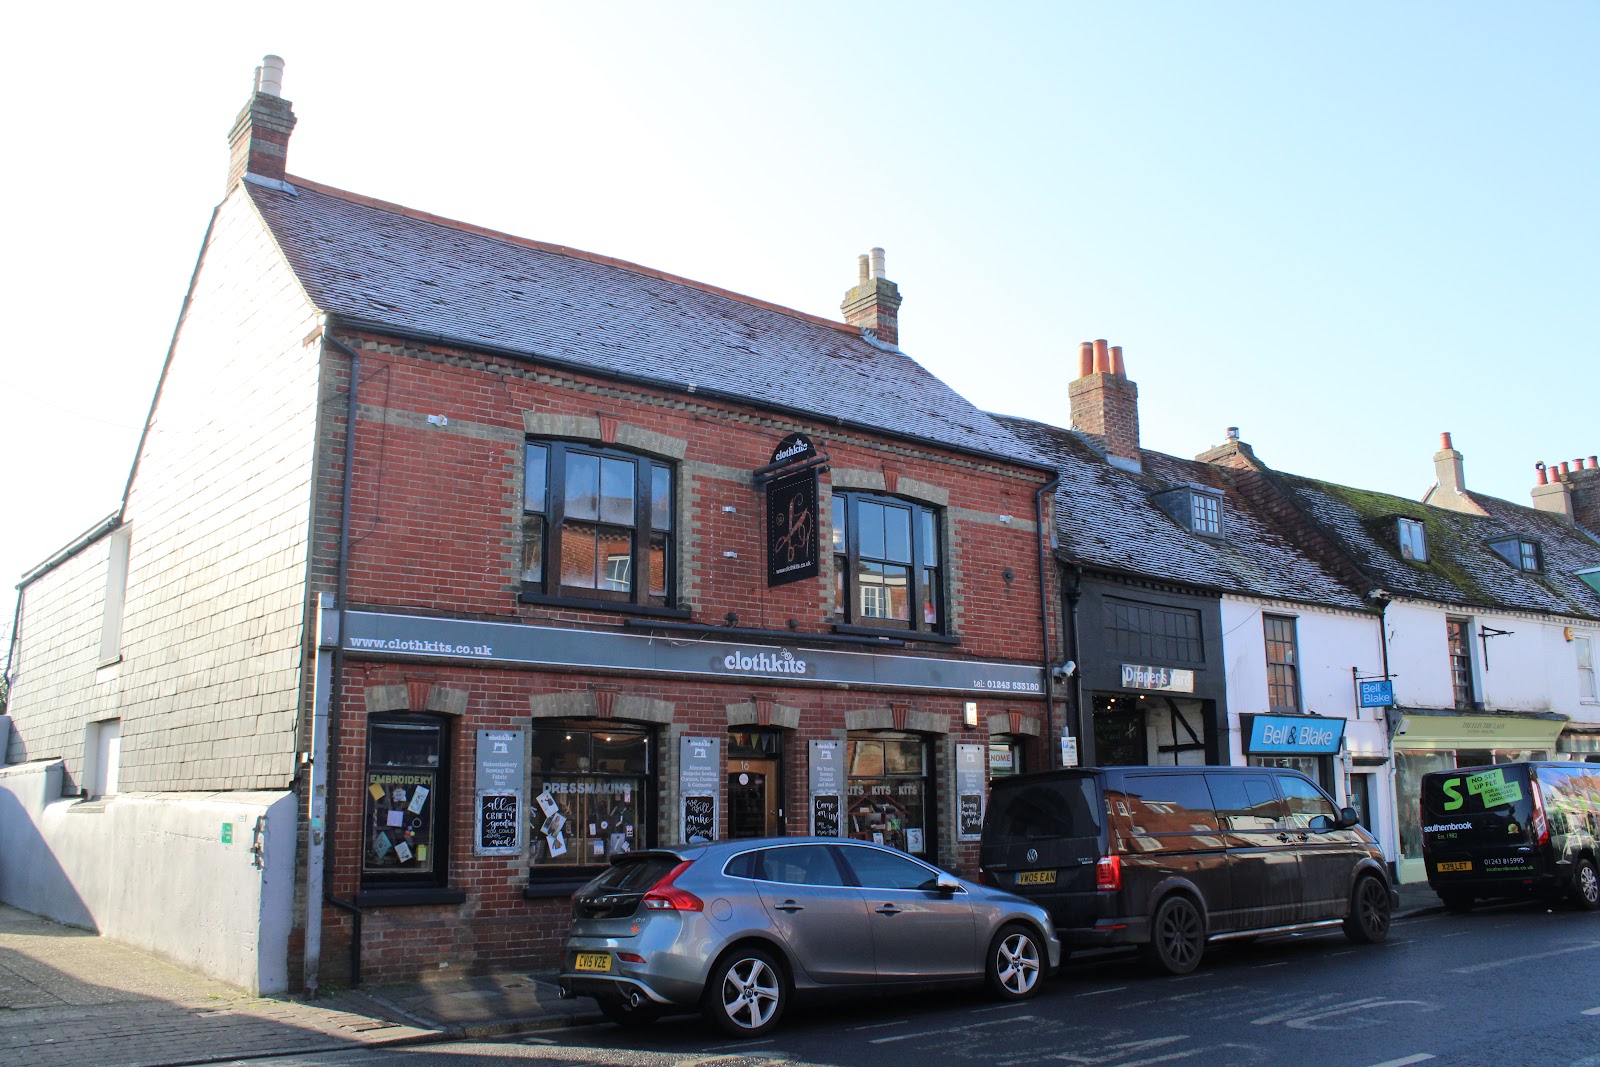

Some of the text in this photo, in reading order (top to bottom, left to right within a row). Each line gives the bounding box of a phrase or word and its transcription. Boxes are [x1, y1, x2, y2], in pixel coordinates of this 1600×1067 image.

[776, 444, 808, 461] clothkits
[350, 637, 492, 656] www.clothkits.co.uk
[724, 650, 807, 674] clothkits
[1125, 666, 1191, 688] Draper's Yard
[973, 679, 1040, 691] tel: 01243 533180
[1363, 682, 1388, 694] Bell &
[1363, 693, 1390, 704] Blake
[1262, 725, 1333, 746] Bell & Blake
[741, 760, 750, 770] 16
[370, 774, 432, 785] EMBROIDERY
[1471, 772, 1497, 784] NO SET
[1485, 779, 1498, 787] FEE
[542, 782, 631, 794] DRESSMAKING
[1489, 788, 1513, 797] MANAGED
[1504, 783, 1516, 791] NEW
[483, 797, 507, 811] all
[1488, 793, 1517, 803] LANDLORDS
[486, 812, 513, 820] CRAFTY
[1424, 821, 1472, 833] southernbrook
[1455, 862, 1468, 870] LET
[1484, 858, 1502, 866] 01243
[1020, 871, 1056, 883] VW05 EAN
[579, 955, 608, 969] CV15 VZE
